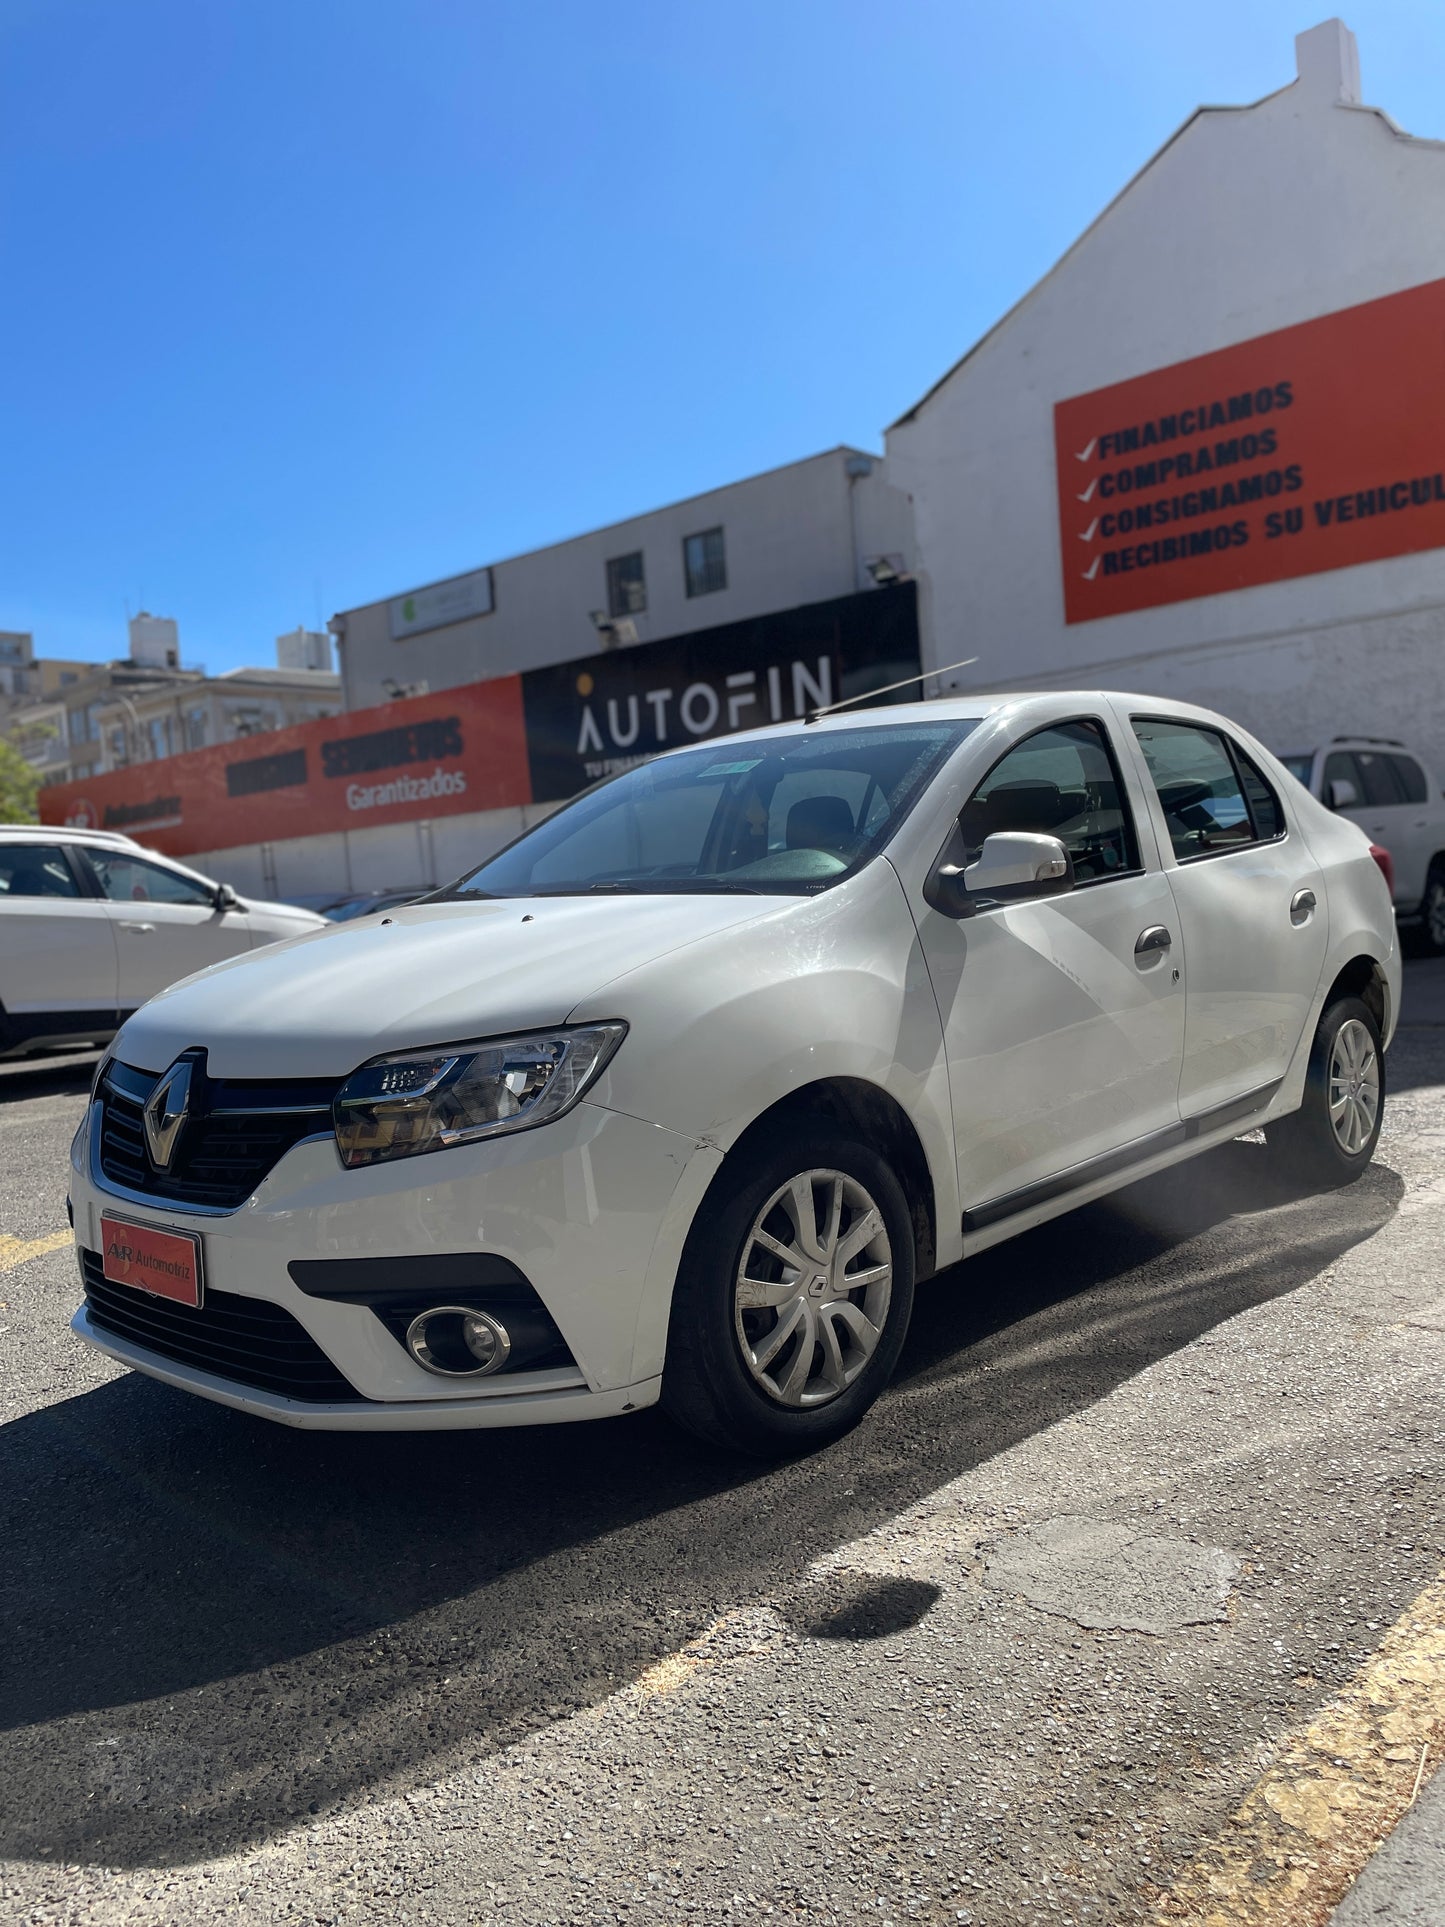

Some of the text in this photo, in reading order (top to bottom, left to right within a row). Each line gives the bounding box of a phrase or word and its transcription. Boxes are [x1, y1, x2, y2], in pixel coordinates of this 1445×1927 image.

[1099, 381, 1294, 460] FINANCIAMOS
[1099, 428, 1278, 498] COMPRAMOS
[1100, 465, 1304, 538] CONSIGNAMOS
[1102, 521, 1249, 577] RECIBIMOS
[1265, 507, 1304, 539] SU
[577, 656, 832, 754] AUTOFIN
[346, 767, 467, 811] Garantizados
[135, 1249, 190, 1280] Automotriz
